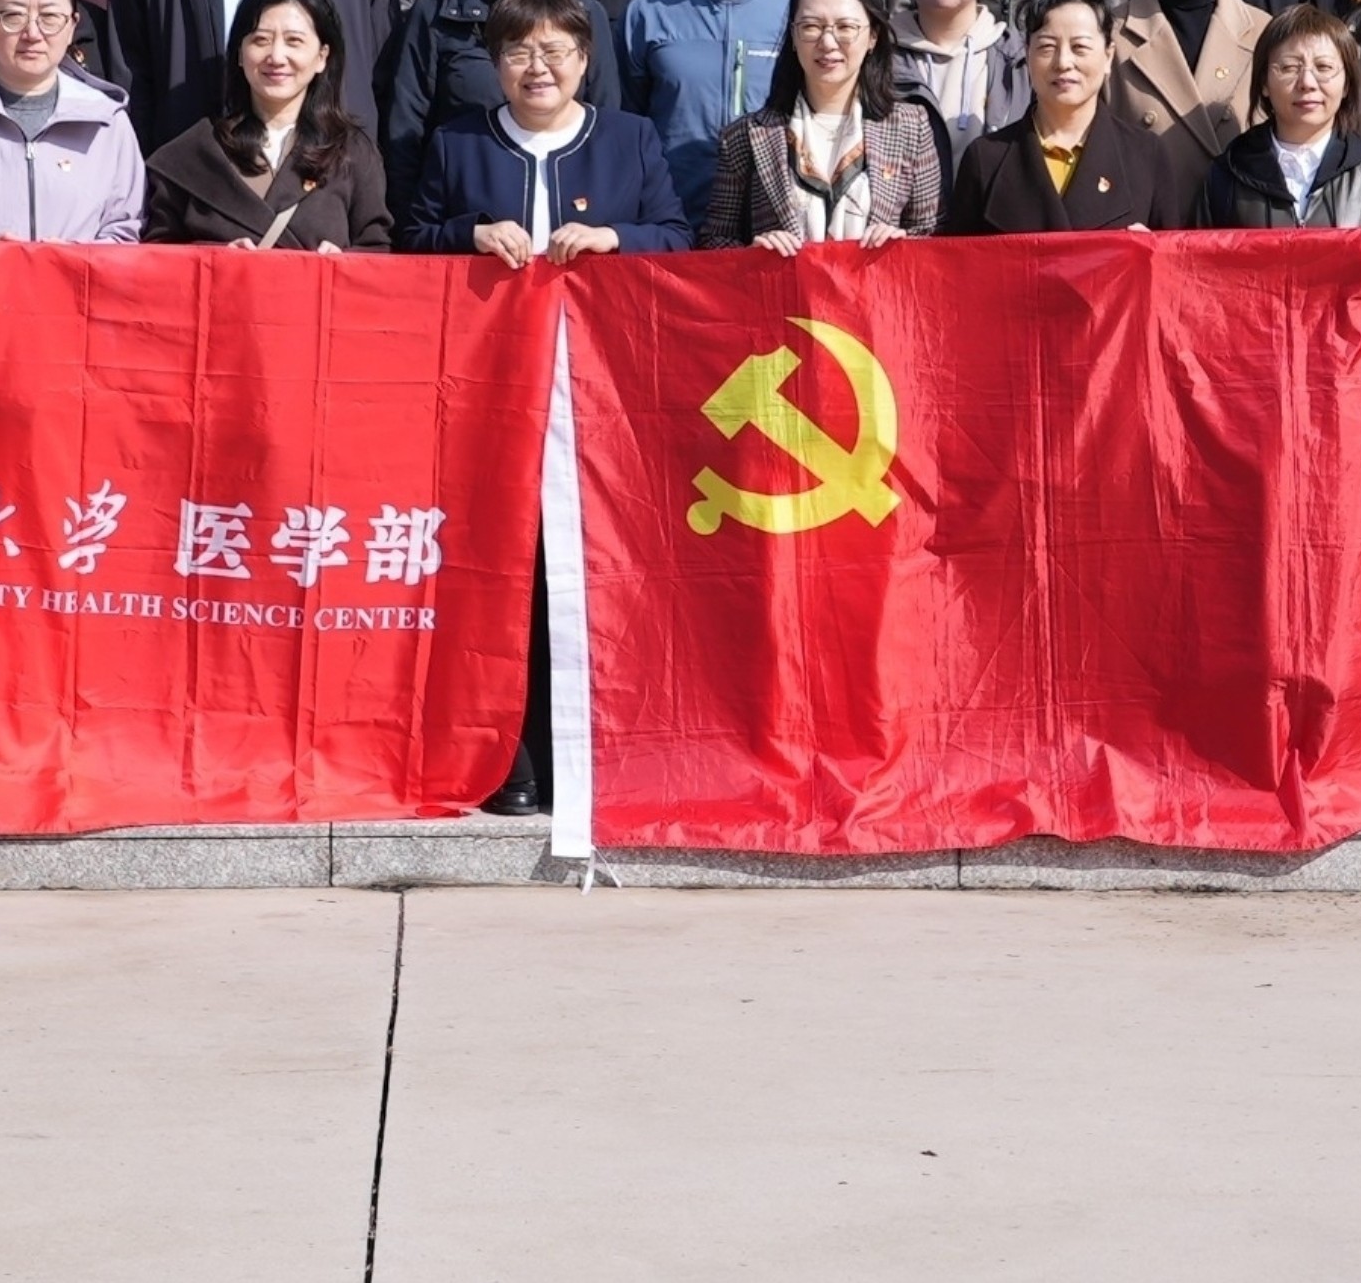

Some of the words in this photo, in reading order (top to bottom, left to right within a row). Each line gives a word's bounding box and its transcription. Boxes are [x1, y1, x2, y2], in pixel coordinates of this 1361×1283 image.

[41, 588, 164, 618] HEALTH
[171, 597, 304, 628] SCIENCE
[314, 606, 436, 631] CENTER
